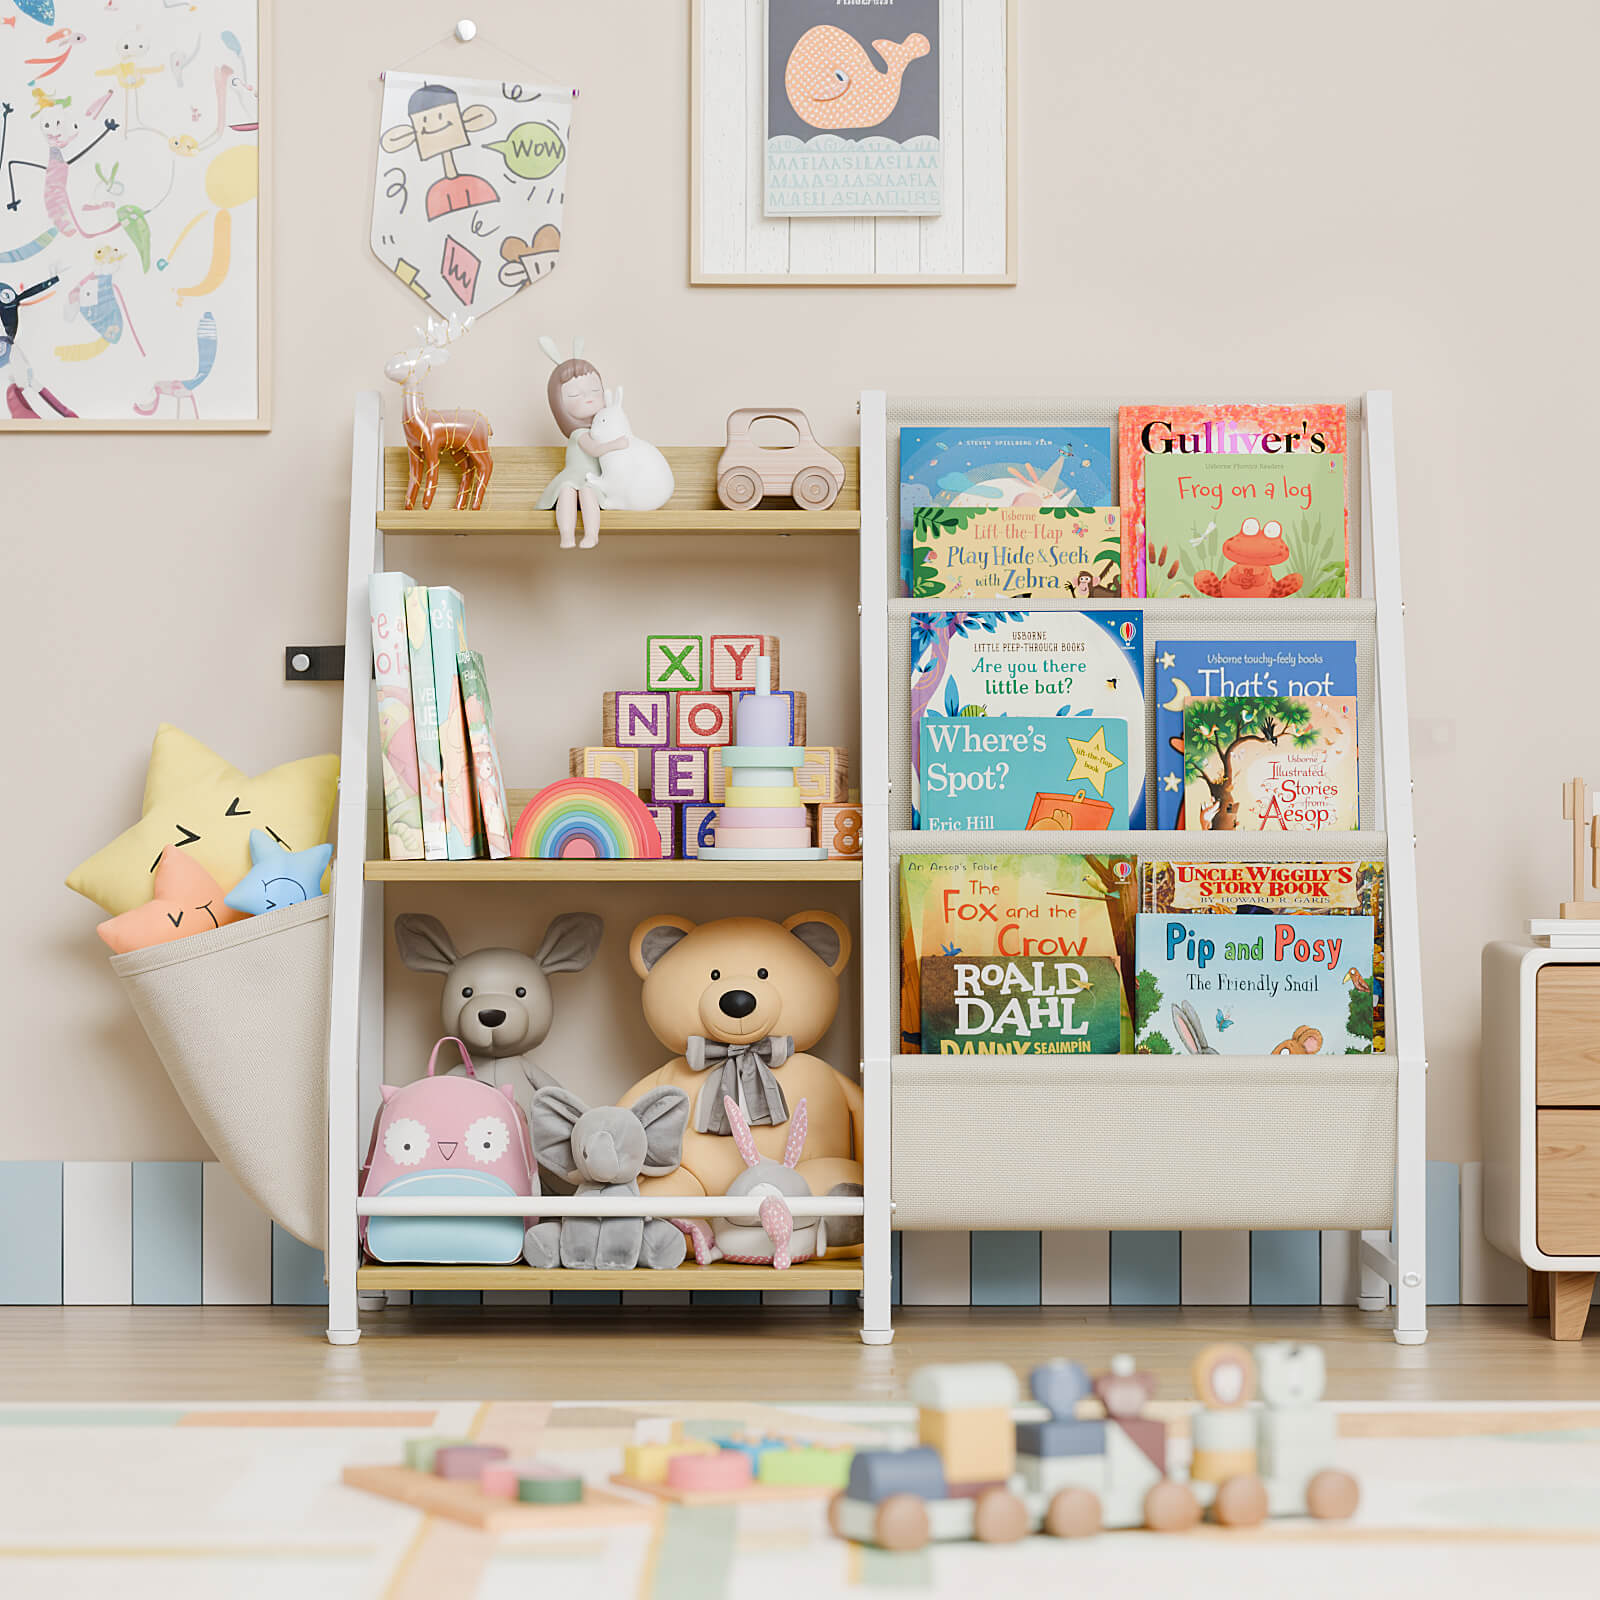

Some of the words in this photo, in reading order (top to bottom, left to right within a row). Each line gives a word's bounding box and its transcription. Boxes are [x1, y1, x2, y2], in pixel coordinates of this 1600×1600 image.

[1141, 420, 1326, 454] Gulliver's
[1178, 476, 1223, 510] Frog
[1231, 484, 1256, 499] on
[1264, 482, 1274, 500] a
[1283, 475, 1312, 510] log
[1001, 511, 1036, 521] Usborne
[974, 523, 1063, 544] Lift-the-Flap
[947, 546, 988, 569] Play
[992, 546, 1034, 566] Hide
[1038, 549, 1048, 563] &
[1049, 546, 1089, 567] Seek
[975, 573, 1000, 587] with
[1002, 568, 1059, 591] Zebra
[974, 643, 1000, 652] LITTLE
[1003, 642, 1058, 652] PEEP-THROUGH
[1061, 642, 1085, 652] BOOKS
[1012, 631, 1047, 641] USBORNE
[656, 645, 696, 682] X
[724, 644, 754, 680] Y
[971, 657, 1002, 673] Are
[1008, 662, 1038, 679] you
[1043, 659, 1087, 673] there
[1207, 653, 1242, 664] Usborne
[1244, 652, 1296, 667] touchy-feely
[1298, 653, 1323, 664] books
[985, 680, 1029, 695] little
[1035, 677, 1073, 695] bat?
[1197, 667, 1278, 697] That's
[1288, 672, 1334, 697] not
[628, 703, 658, 736] N
[687, 702, 723, 737] O
[926, 725, 1047, 753] Where's
[1084, 761, 1098, 773] book
[1265, 761, 1326, 779] Illustrated
[1287, 754, 1318, 763] Usborne
[668, 754, 694, 796] E
[794, 753, 826, 797] G
[927, 762, 1009, 798] Spot?
[1281, 779, 1338, 803] Stories
[1305, 797, 1326, 809] from
[928, 817, 961, 830] Eric
[967, 816, 994, 830] Hill
[1259, 795, 1329, 831] Aesop
[833, 809, 862, 854] 8
[908, 862, 924, 871] An
[930, 862, 967, 872] Aesop's
[1176, 866, 1243, 883] UNCLE
[1245, 866, 1353, 884] WIGGILY'S
[968, 880, 999, 895] The
[1200, 882, 1263, 897] STORY
[1269, 882, 1329, 897] BOOK
[943, 889, 998, 923] Fox
[1006, 905, 1039, 918] and
[1048, 904, 1077, 918] the
[998, 923, 1088, 957] Crow
[1166, 922, 1215, 968] Pip
[1224, 936, 1264, 961] and
[1274, 923, 1342, 970] Posy
[953, 961, 1089, 997] ROALD
[1186, 973, 1212, 991] The
[1217, 973, 1279, 998] Friendly
[1284, 974, 1318, 992] Snail
[954, 997, 1089, 1037] DAHL
[940, 1039, 1032, 1055] DANNY
